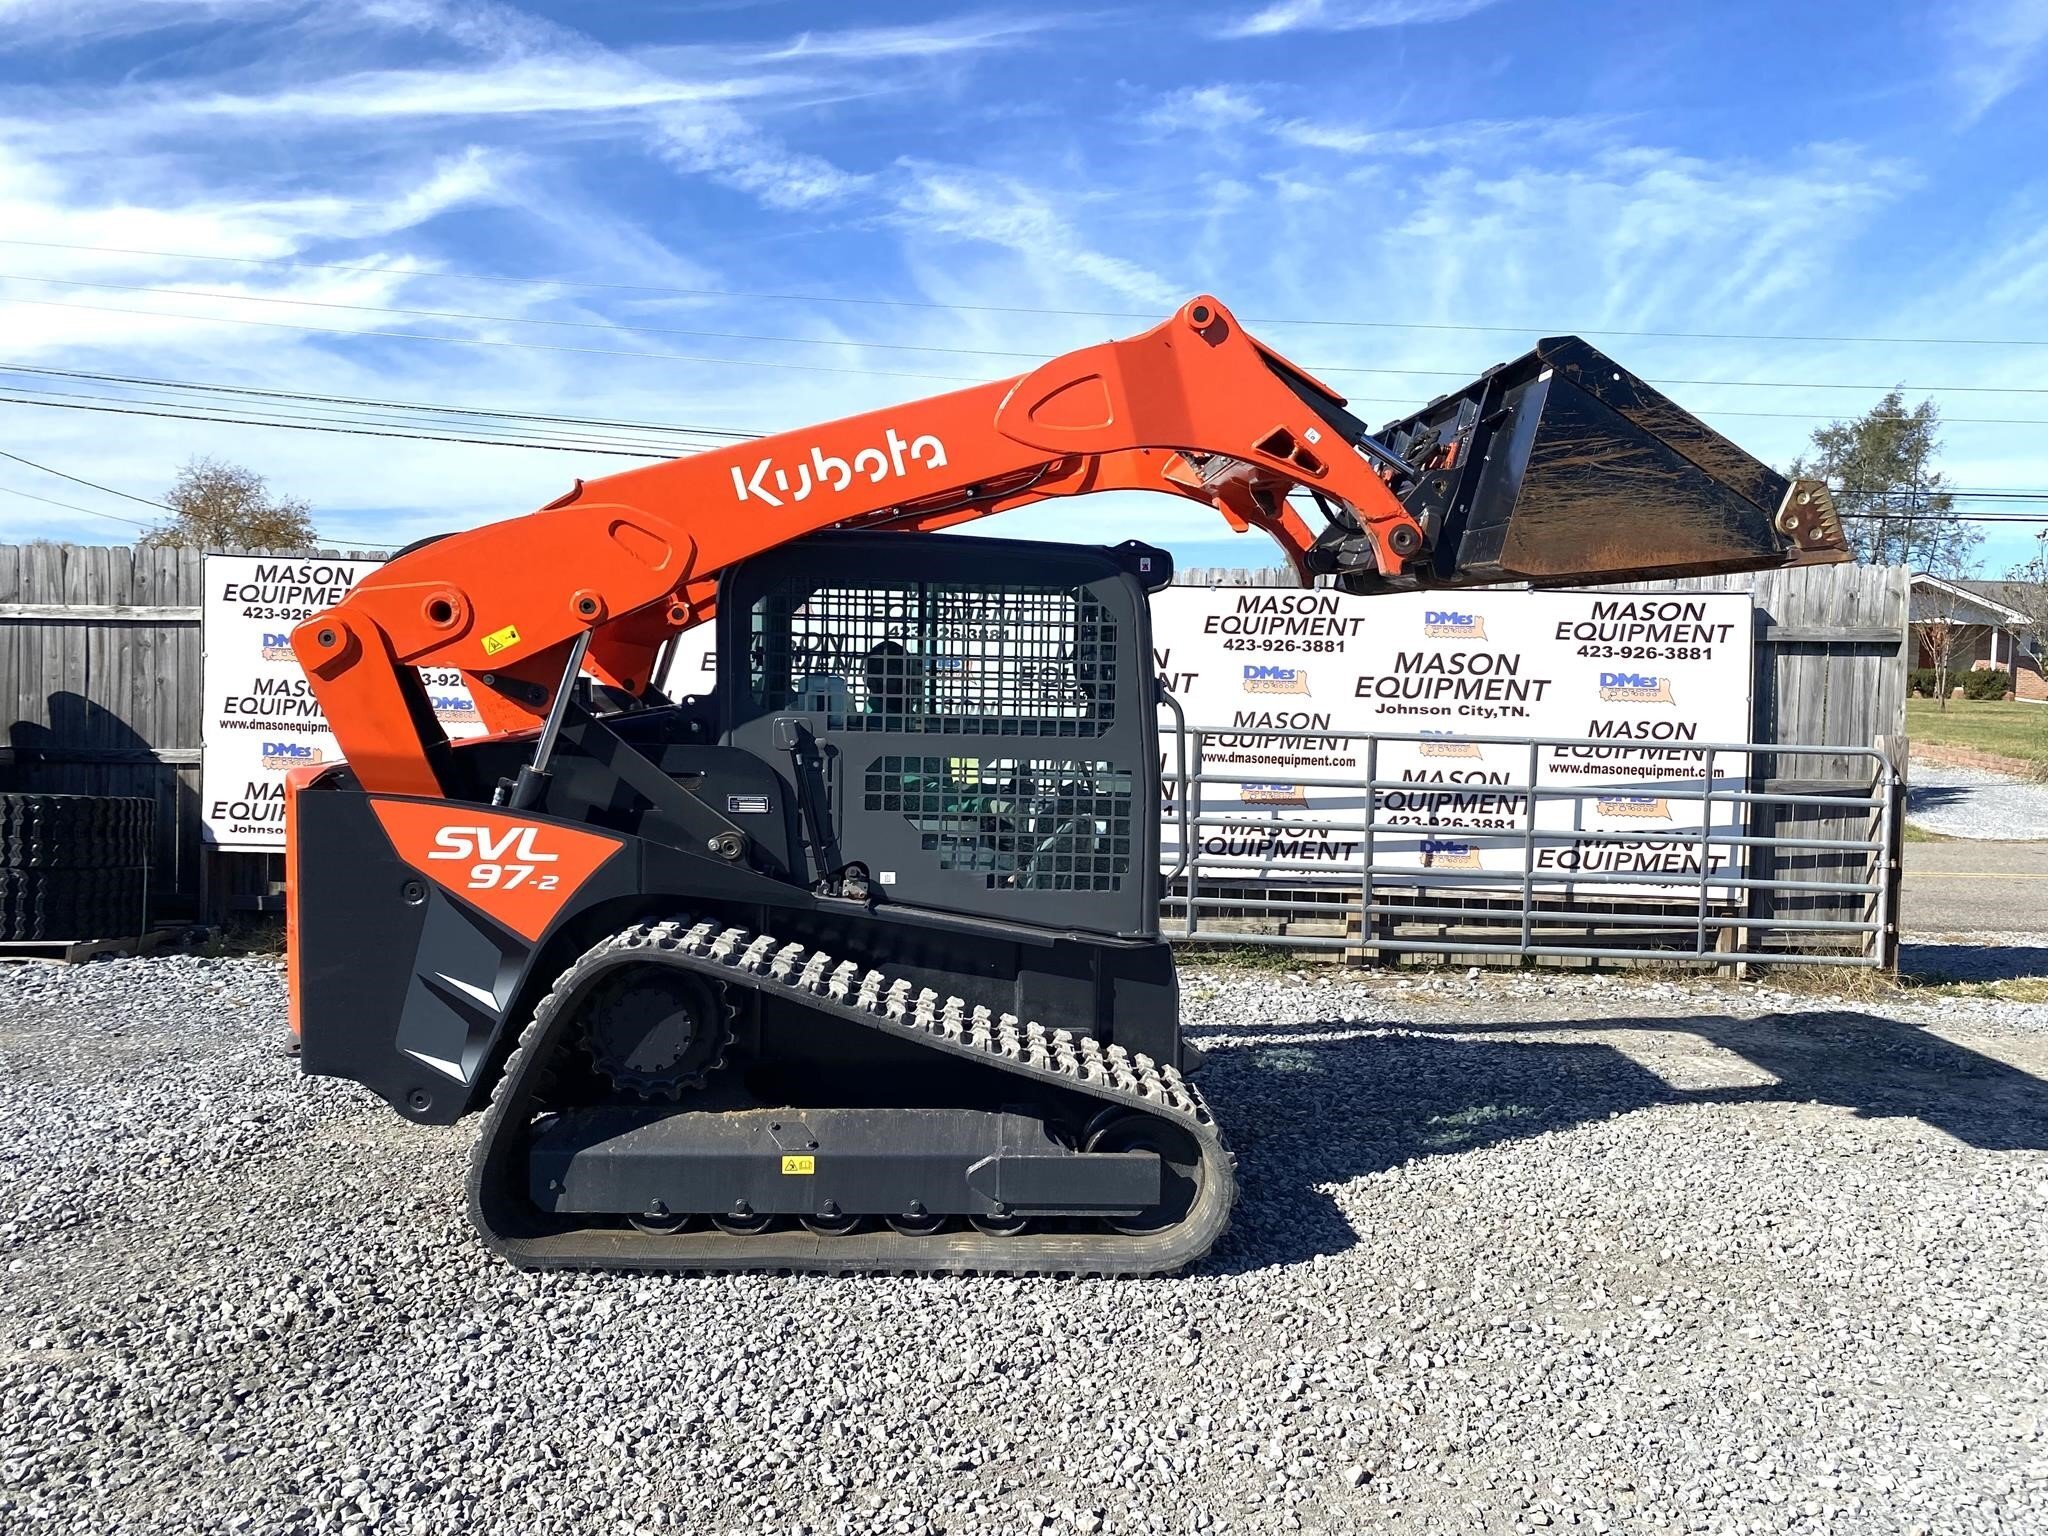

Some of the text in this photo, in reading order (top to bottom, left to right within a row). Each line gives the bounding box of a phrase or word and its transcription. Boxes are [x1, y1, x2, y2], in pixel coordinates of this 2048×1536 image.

[730, 428, 948, 507] Kubota
[255, 564, 354, 585] MASON
[1236, 595, 1340, 615] MASON
[1591, 601, 1706, 621] MASON
[1204, 615, 1365, 636] EQUIPMENT
[1555, 621, 1734, 643] EQUIPMENT
[1223, 639, 1345, 653] 423-926-3881
[1577, 645, 1712, 660] 423-926-3881
[1394, 652, 1520, 675] MASON
[1355, 676, 1552, 701] EQUIPMENT
[1375, 703, 1451, 715] Johnson
[1233, 711, 1331, 730] MASON
[1588, 720, 1697, 741] MASON
[1549, 762, 1725, 779] www.dmasonequipment.cm
[427, 826, 559, 862] SVL
[467, 864, 560, 890] 97-2
